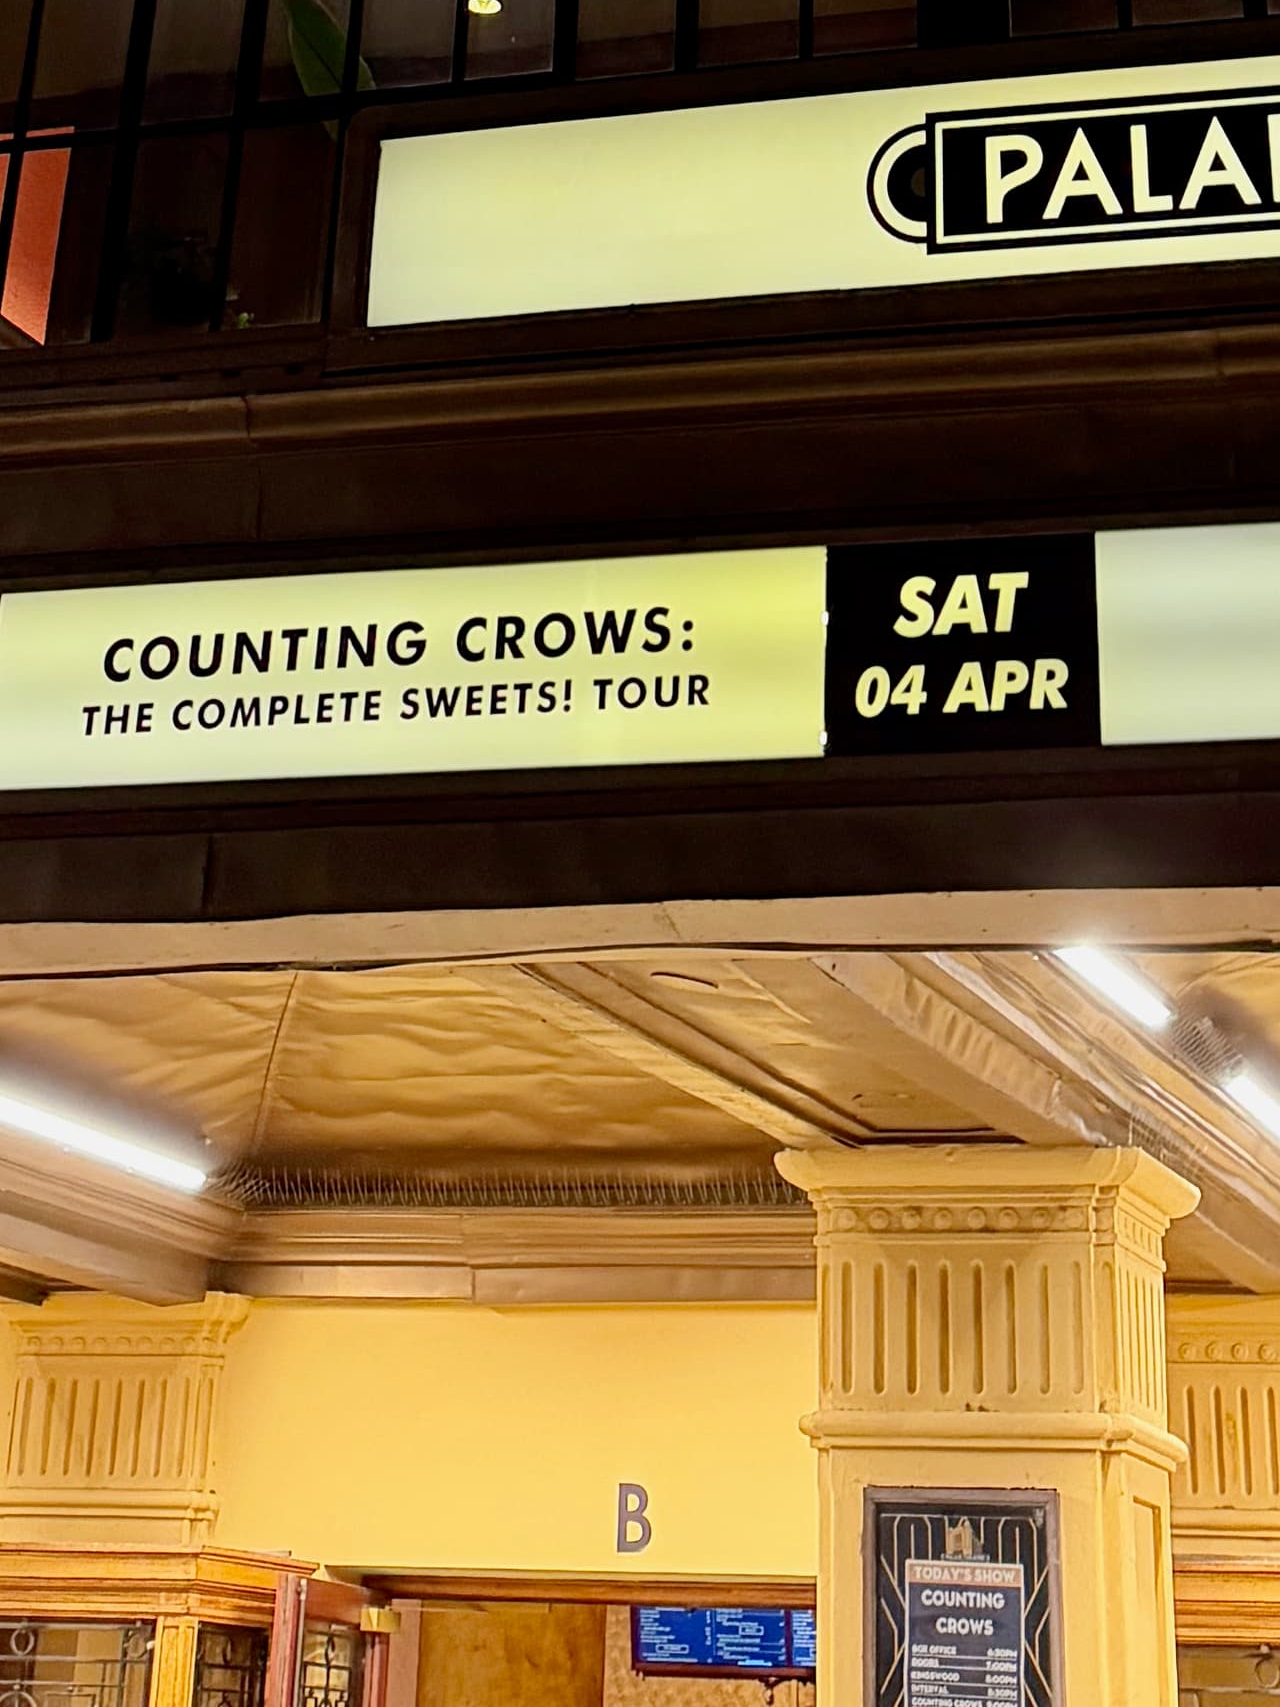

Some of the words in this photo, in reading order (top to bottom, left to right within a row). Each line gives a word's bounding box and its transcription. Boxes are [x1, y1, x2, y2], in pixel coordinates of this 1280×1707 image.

[893, 571, 1030, 638] SAT
[103, 620, 428, 683] COUNTING
[456, 606, 696, 664] CROWS:
[82, 703, 154, 736] THE
[172, 690, 382, 731] COMPLETE
[399, 679, 572, 720] SWEETS!
[593, 674, 710, 710] TOUR
[855, 664, 928, 718] 04
[942, 658, 1069, 714] APR
[616, 1482, 652, 1553] B
[913, 1566, 971, 1583] TODAY'S
[974, 1567, 1016, 1583] SHOW
[920, 1588, 1006, 1610] COUNTING
[935, 1616, 995, 1636] CROWS
